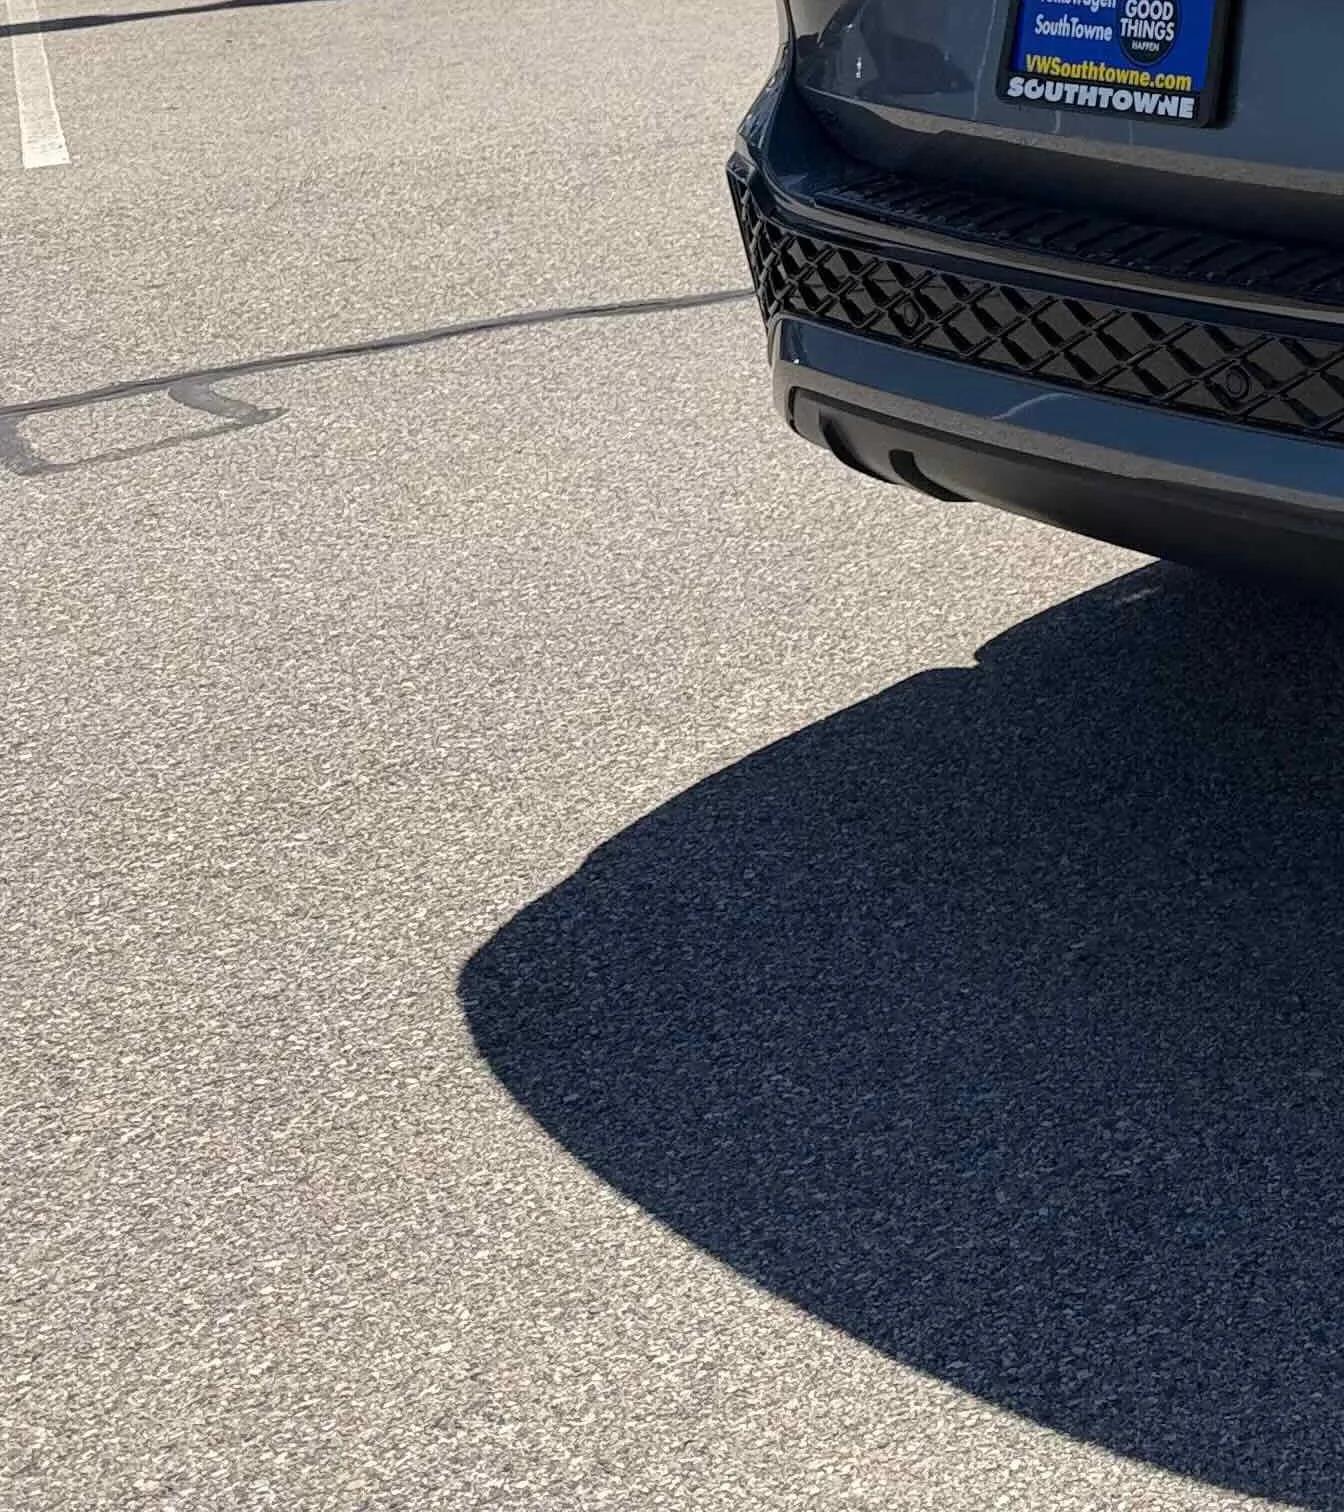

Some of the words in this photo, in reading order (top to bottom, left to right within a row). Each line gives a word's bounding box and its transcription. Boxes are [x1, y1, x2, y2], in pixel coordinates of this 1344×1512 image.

[1125, 0, 1174, 21] GOOD
[1034, 14, 1113, 42] SouthTowne
[1120, 18, 1175, 41] THINGS
[1025, 54, 1192, 91] VWSouthtowne.com
[1007, 76, 1195, 119] SOUTHTOWNE
